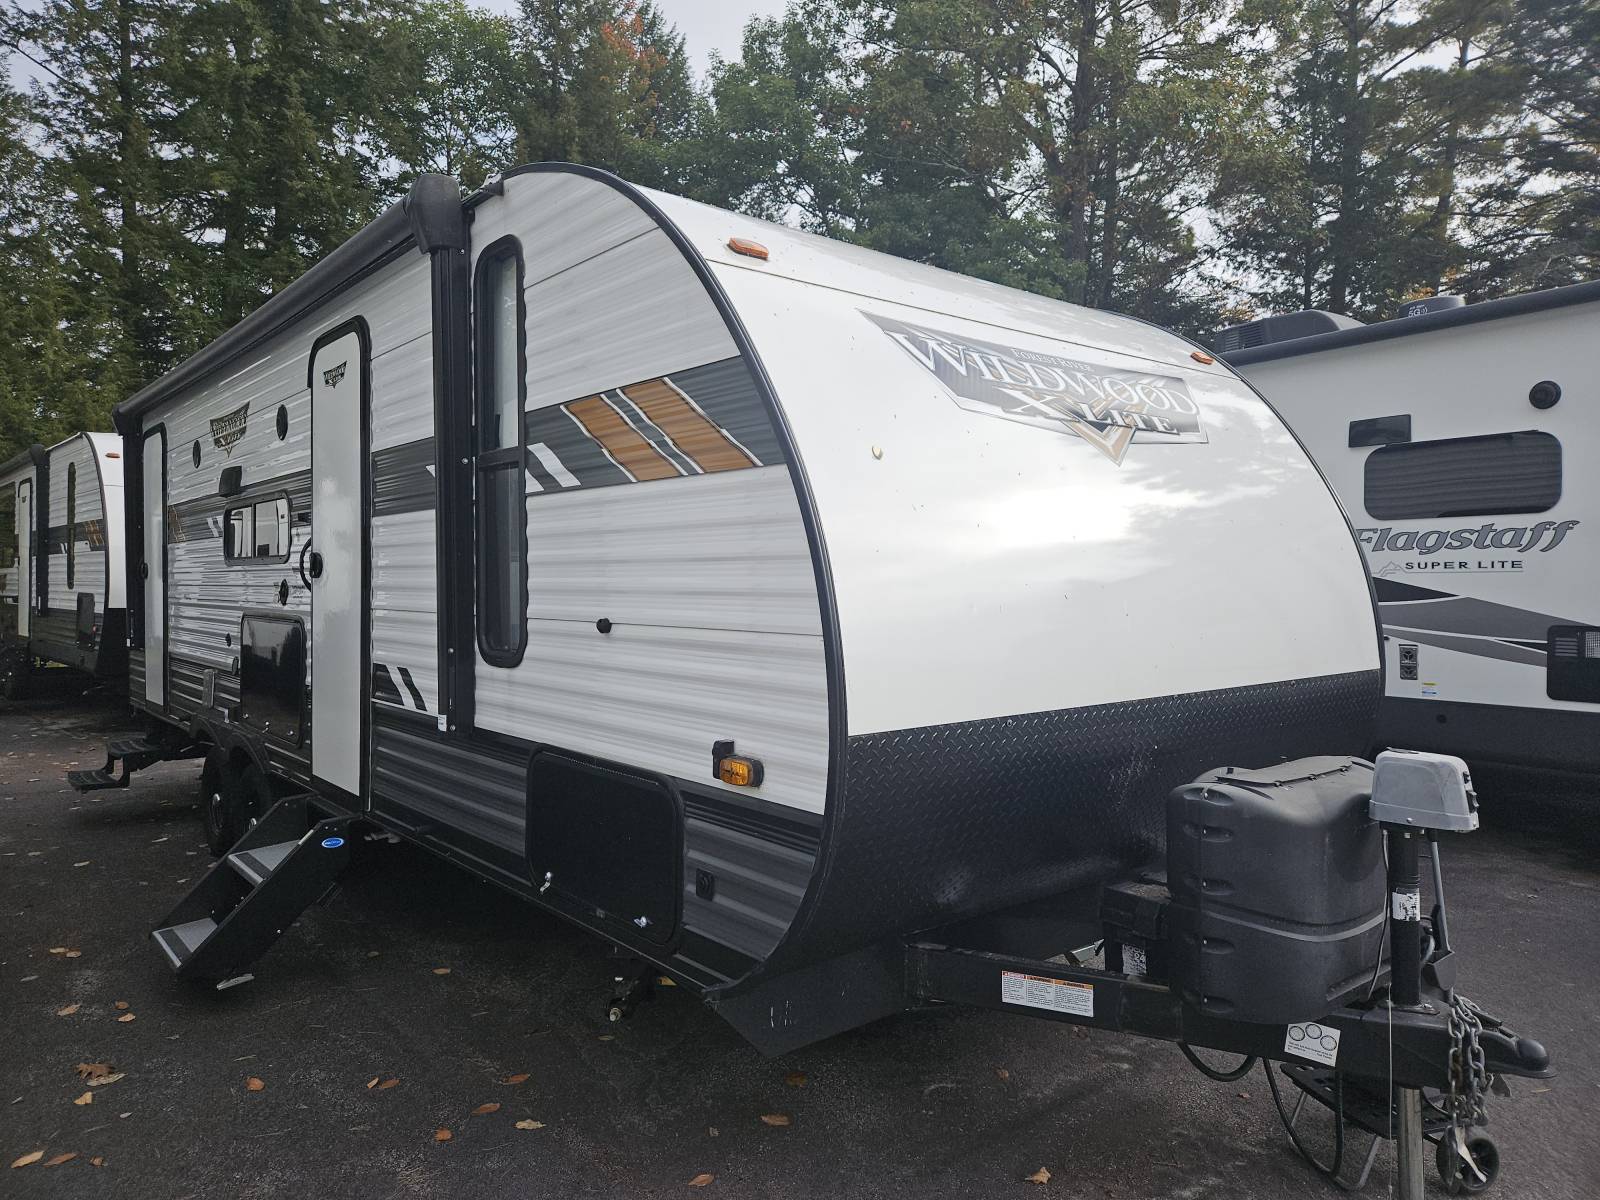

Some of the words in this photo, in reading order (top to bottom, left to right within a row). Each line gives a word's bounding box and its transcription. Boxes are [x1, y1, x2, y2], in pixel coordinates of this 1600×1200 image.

[1408, 308, 1421, 318] 5G
[885, 331, 1199, 415] WILDWOOD
[993, 385, 1078, 422] X
[1078, 402, 1178, 434] LITE
[1356, 519, 1580, 556] Flagstaff
[1405, 561, 1468, 570] SUPER
[1477, 560, 1524, 570] LITE
